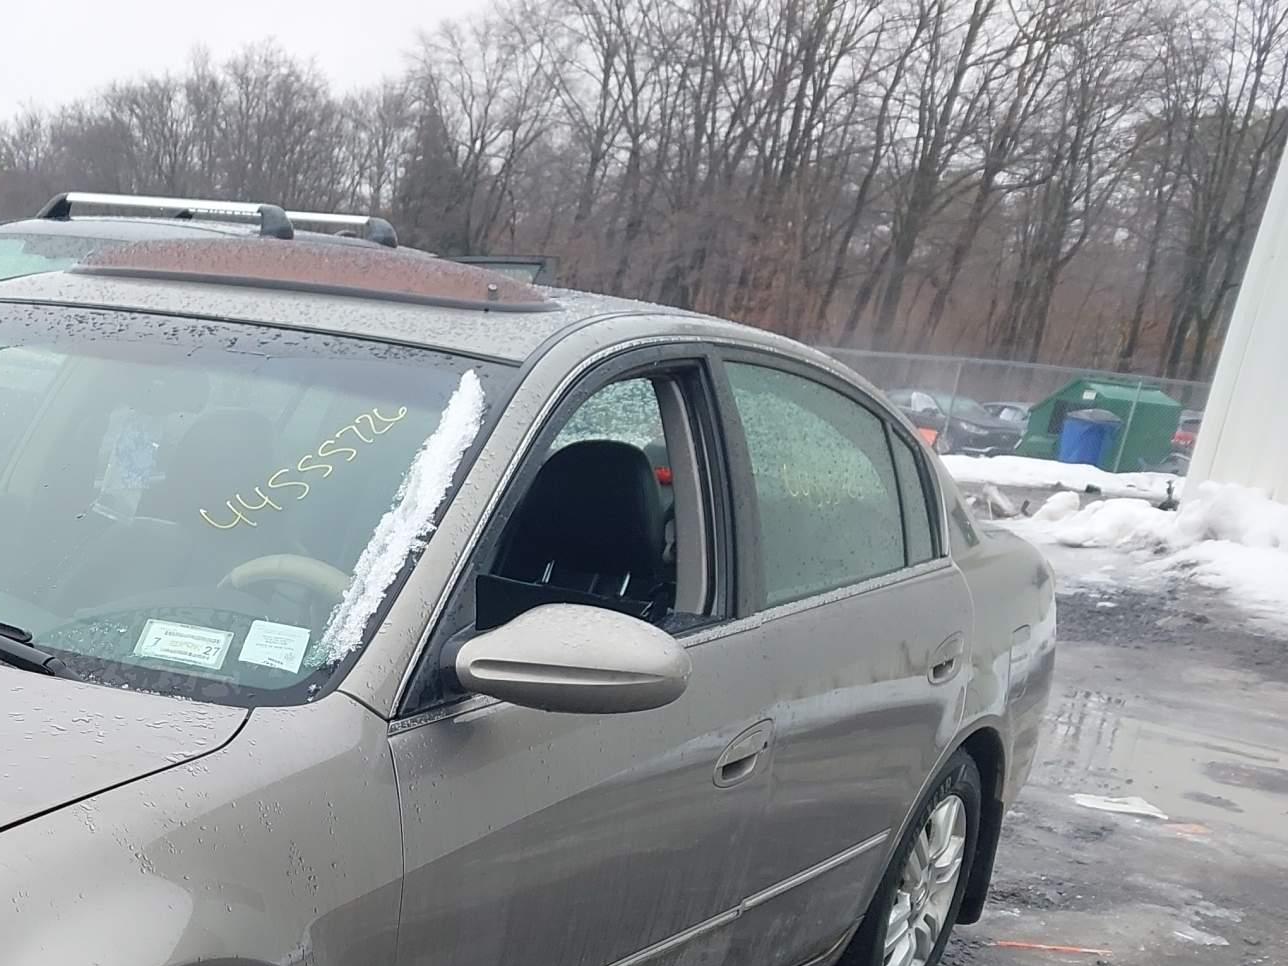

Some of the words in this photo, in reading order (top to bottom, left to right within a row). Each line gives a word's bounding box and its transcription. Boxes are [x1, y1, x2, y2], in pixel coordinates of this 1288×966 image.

[199, 406, 408, 529] 44555726
[151, 636, 161, 647] 7
[203, 645, 221, 657] 27
